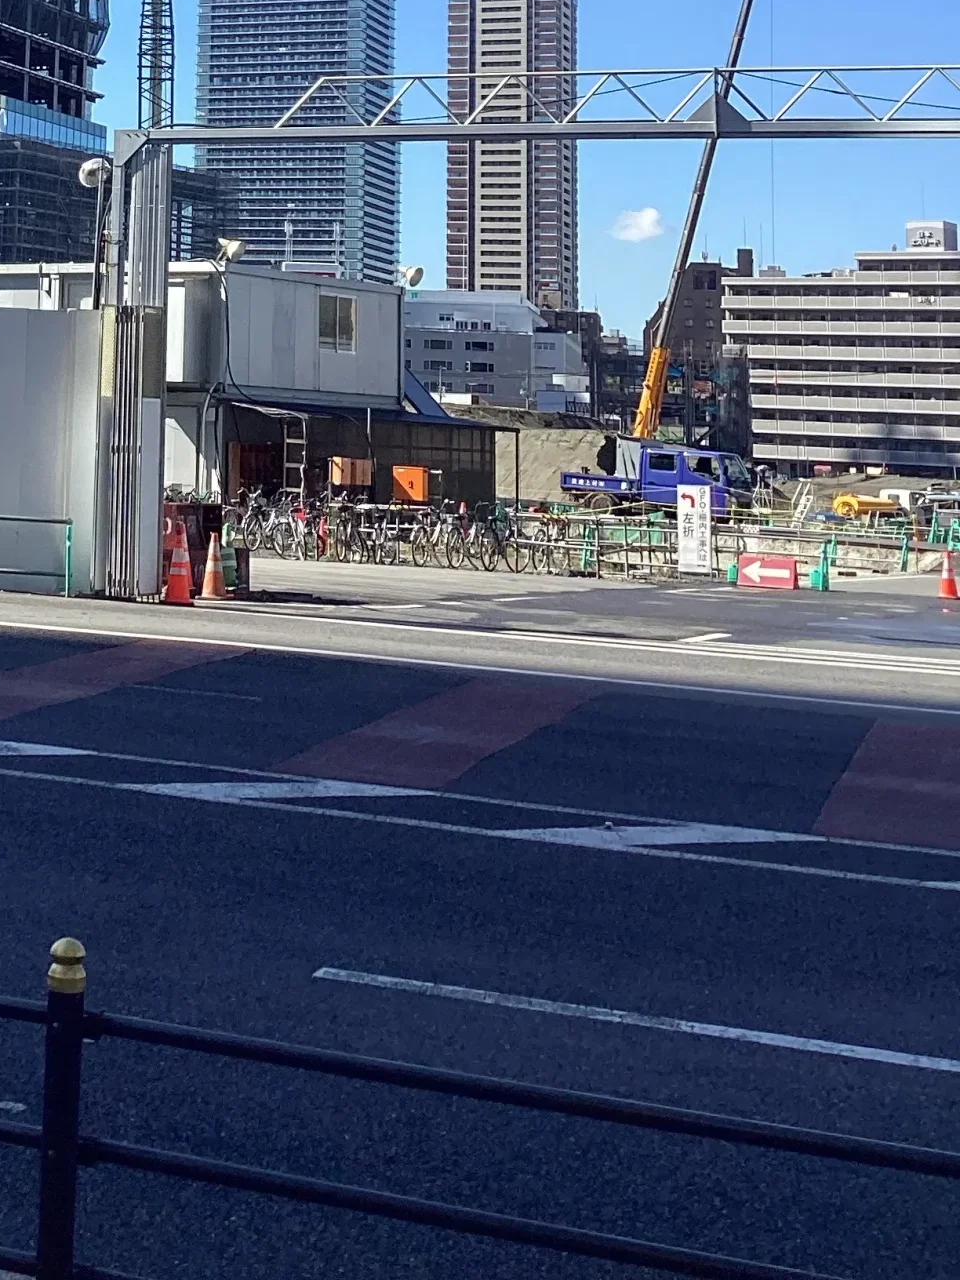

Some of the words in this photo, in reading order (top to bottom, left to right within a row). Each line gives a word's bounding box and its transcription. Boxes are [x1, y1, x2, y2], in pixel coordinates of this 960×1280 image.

[911, 238, 942, 248] エスリード
[682, 512, 695, 538] 左折
